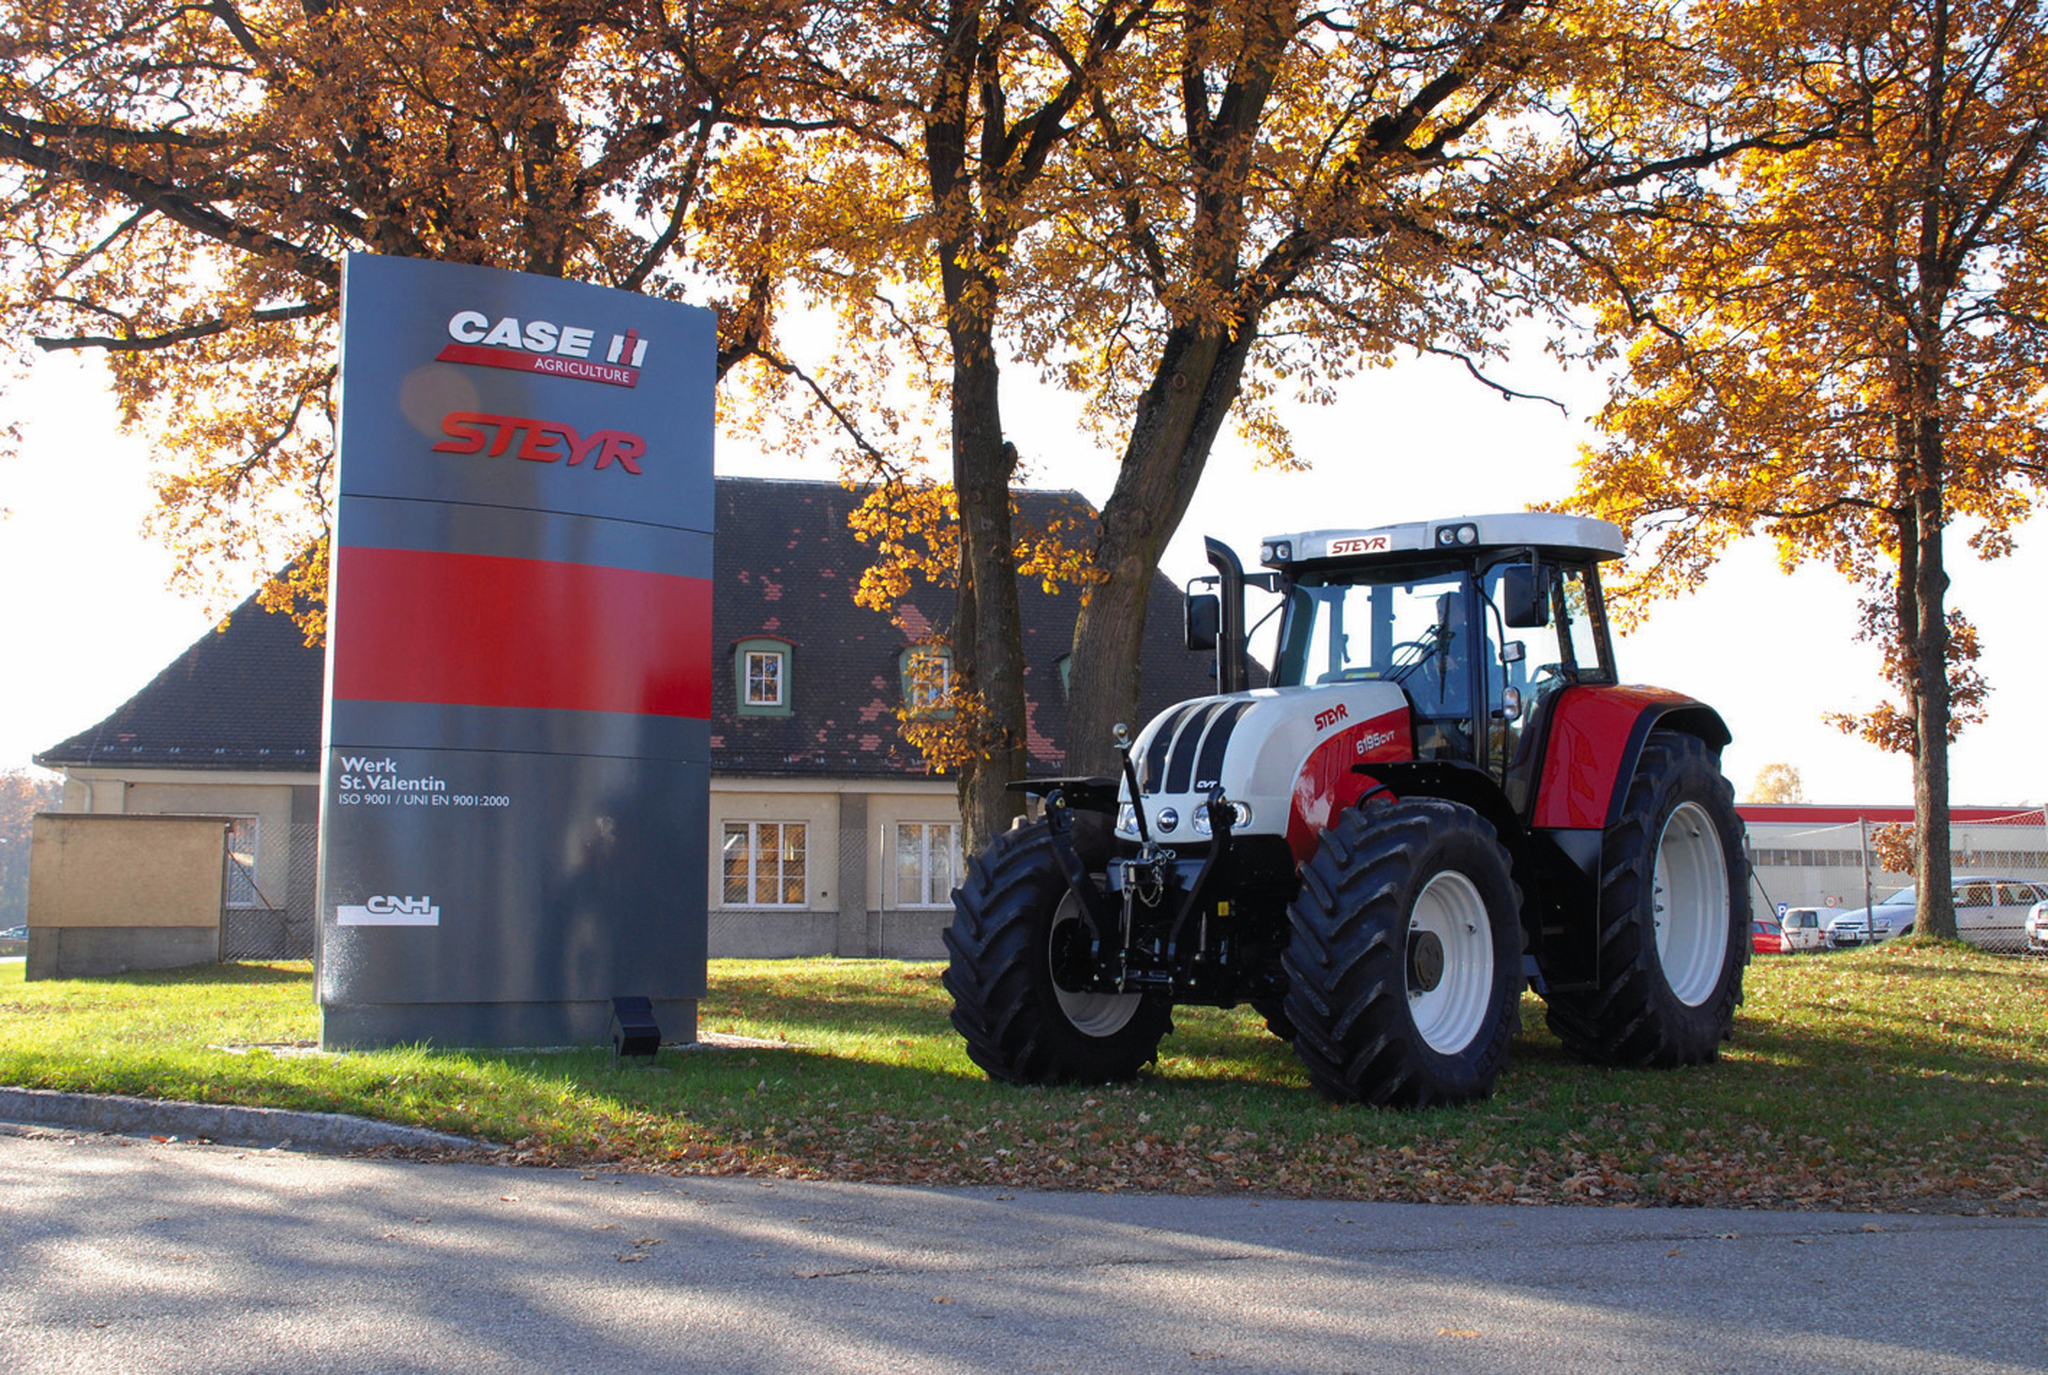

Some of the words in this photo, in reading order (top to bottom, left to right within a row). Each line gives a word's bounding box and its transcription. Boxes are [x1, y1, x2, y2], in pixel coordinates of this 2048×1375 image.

[448, 310, 595, 359] CASE
[534, 357, 630, 384] AGRICULTURE
[432, 410, 647, 475] STEYR
[1331, 537, 1387, 555] STEYR
[1314, 703, 1349, 732] STEYR
[341, 757, 397, 773] Werk
[1196, 780, 1218, 789] CVT
[339, 794, 361, 805] ISO
[364, 794, 392, 805] 9001
[403, 795, 429, 806] UNI
[431, 795, 449, 806] EN
[452, 796, 510, 807] 9001:2000
[367, 895, 430, 914] CNH
